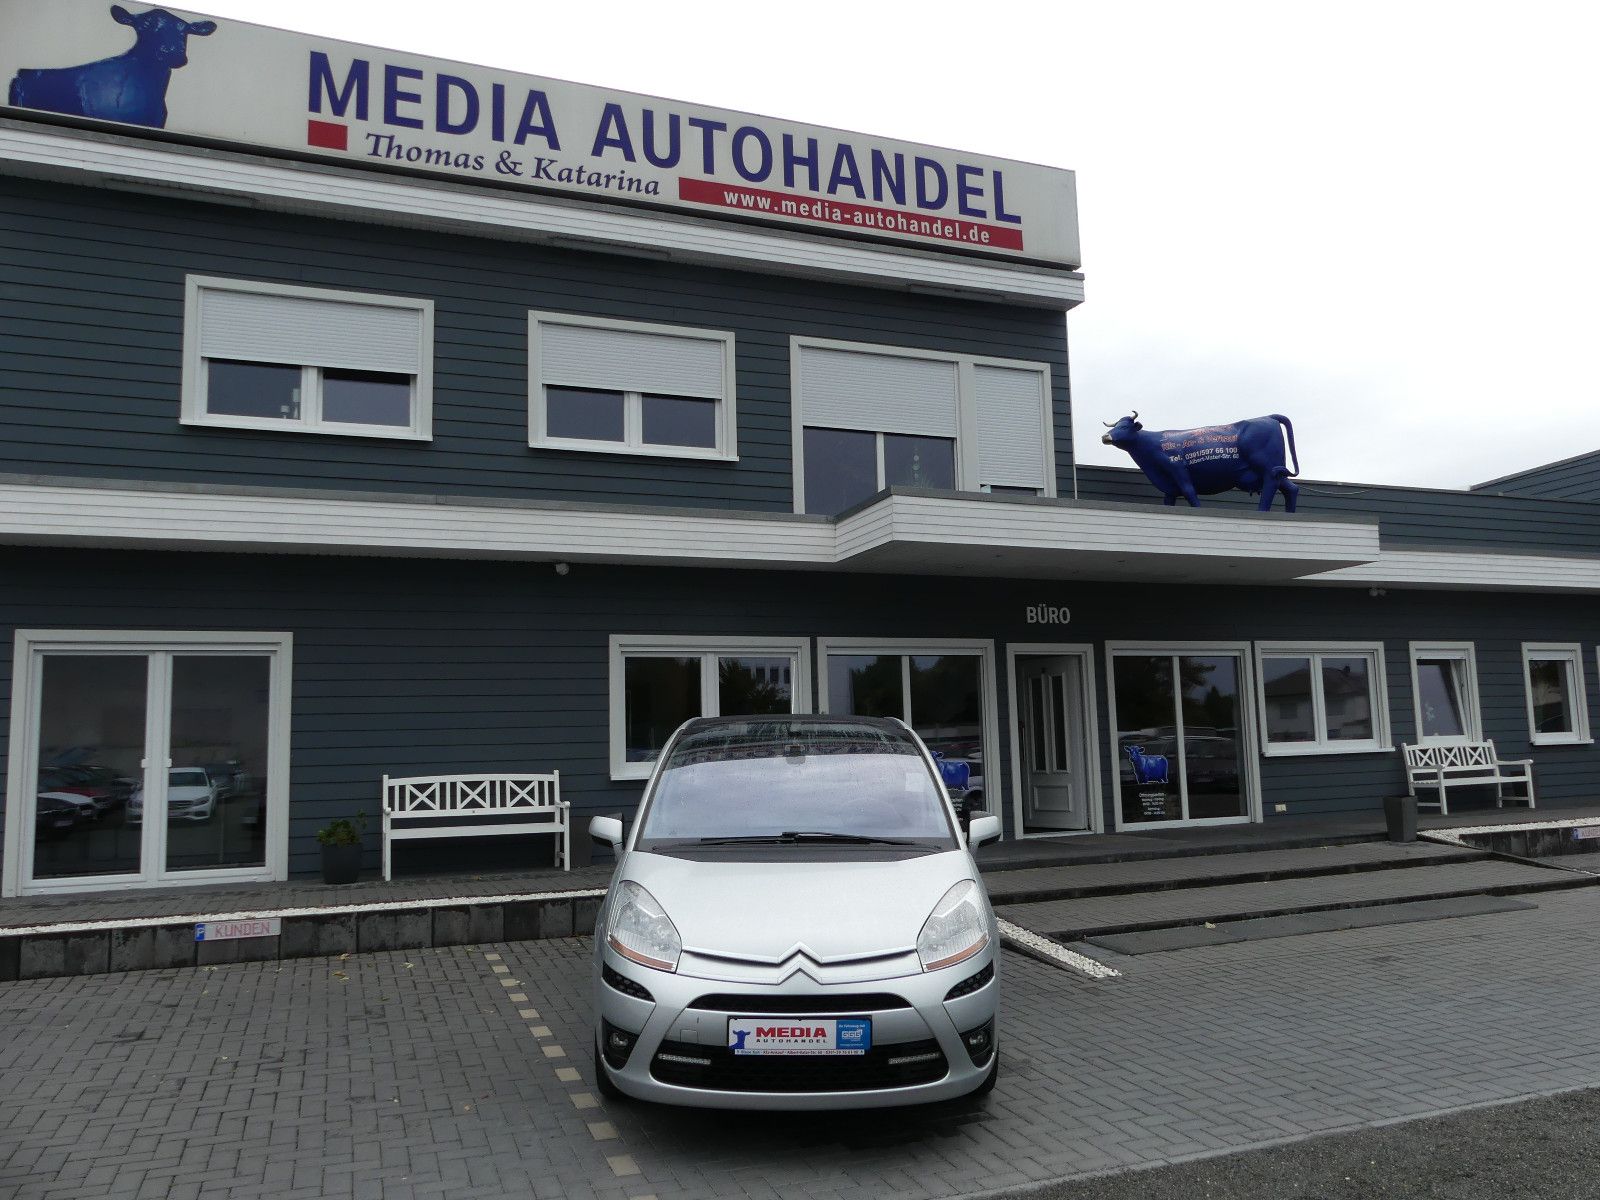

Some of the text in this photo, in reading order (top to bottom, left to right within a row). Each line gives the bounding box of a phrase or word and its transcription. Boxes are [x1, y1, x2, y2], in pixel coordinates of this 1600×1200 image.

[308, 50, 1022, 225] MEDIA AUTOHANDEL
[366, 132, 660, 196] Thomas & Katarina
[724, 190, 990, 244] www.media-autohandel.de
[1169, 455, 1183, 463] Tel.
[1026, 603, 1071, 624] BÜRO
[214, 921, 270, 938] KUNDEN
[755, 1027, 827, 1038] MEDIA
